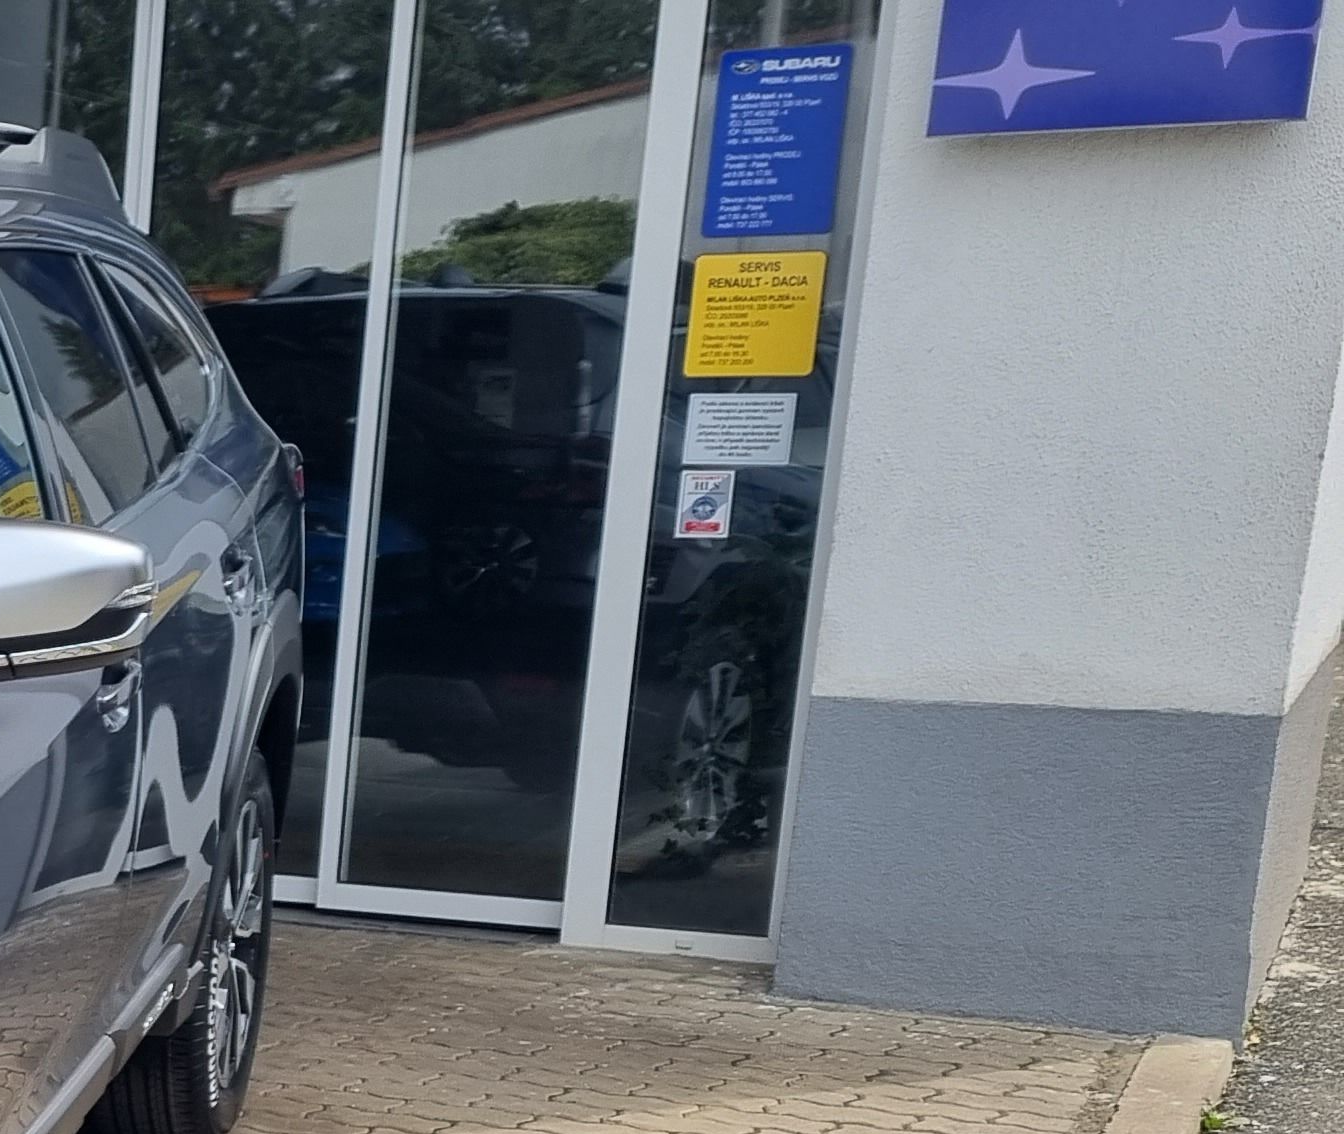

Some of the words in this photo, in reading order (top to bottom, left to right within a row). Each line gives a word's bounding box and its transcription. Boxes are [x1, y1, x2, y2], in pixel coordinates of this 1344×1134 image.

[761, 56, 841, 72] SUBARU
[739, 261, 782, 273] SERVIS
[708, 277, 762, 288] RENAULT
[771, 276, 808, 287] DACIA
